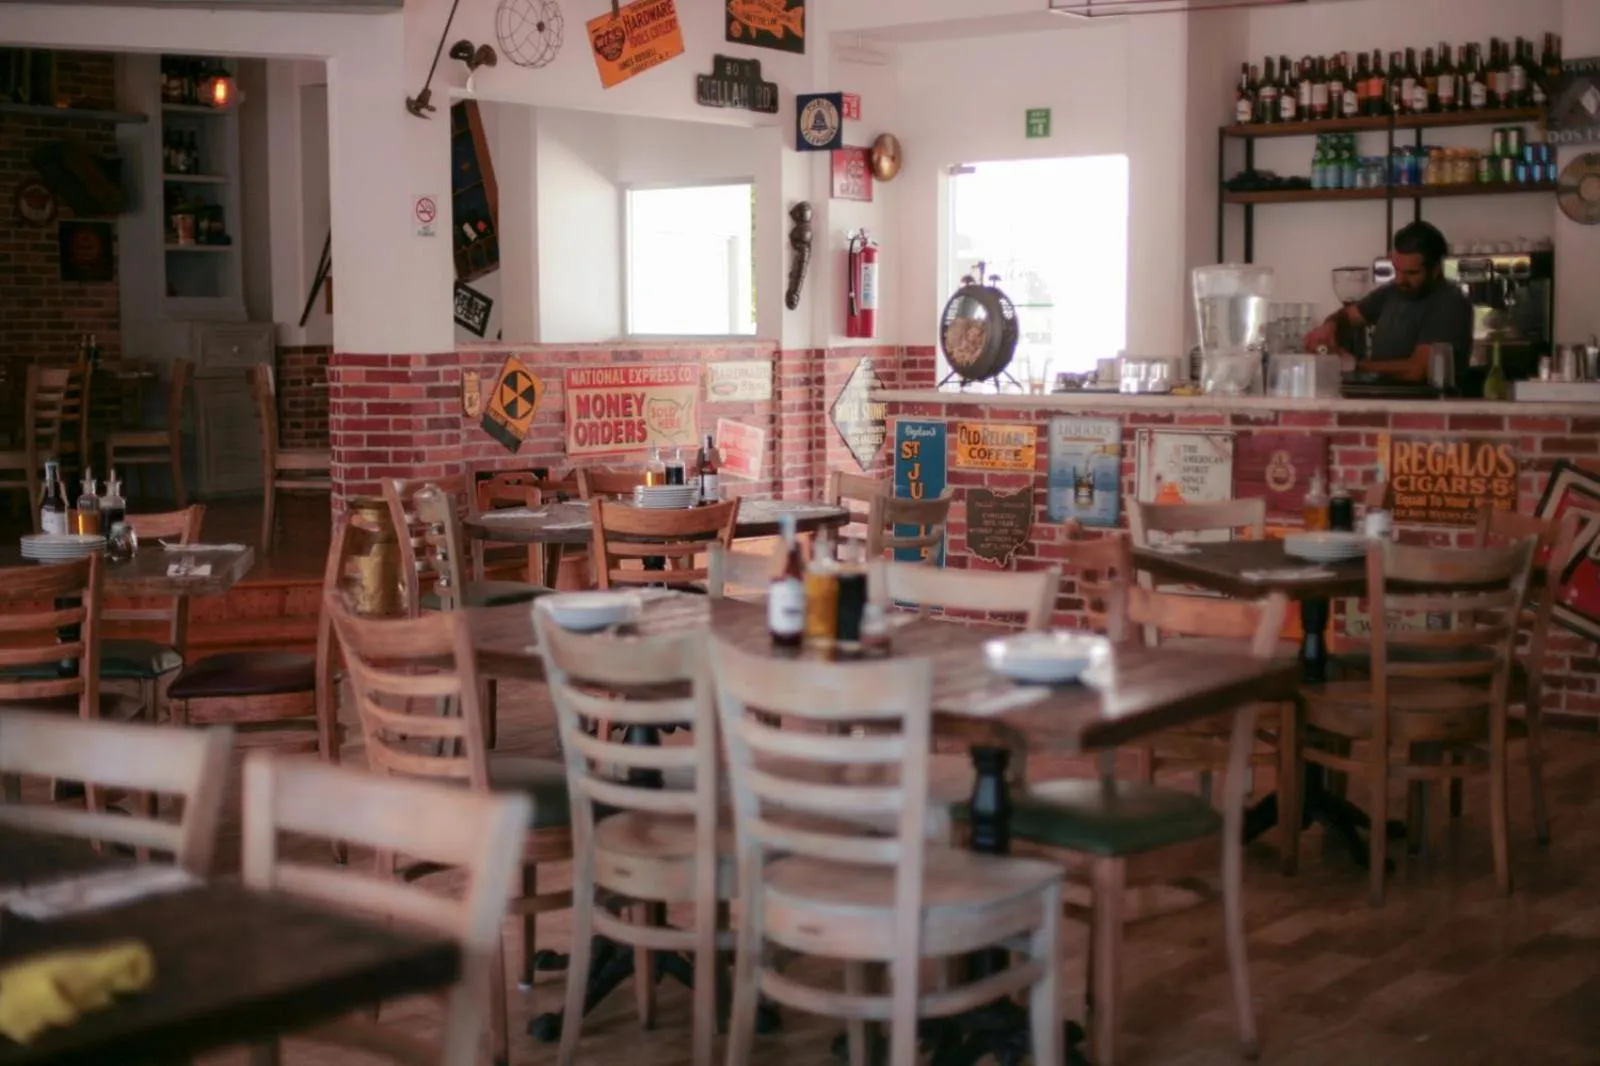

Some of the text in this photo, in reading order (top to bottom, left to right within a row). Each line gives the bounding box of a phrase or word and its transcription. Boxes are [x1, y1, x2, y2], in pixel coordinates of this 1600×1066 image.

[571, 369, 624, 385] NATIONAL
[628, 367, 676, 383] EXPRESS
[575, 391, 646, 419] MONEY
[574, 419, 648, 447] ORDERS
[959, 425, 980, 446] OLD
[968, 447, 1022, 461] COFFEE
[1393, 441, 1516, 478] REGALOS
[1392, 475, 1487, 494] CIGARS
